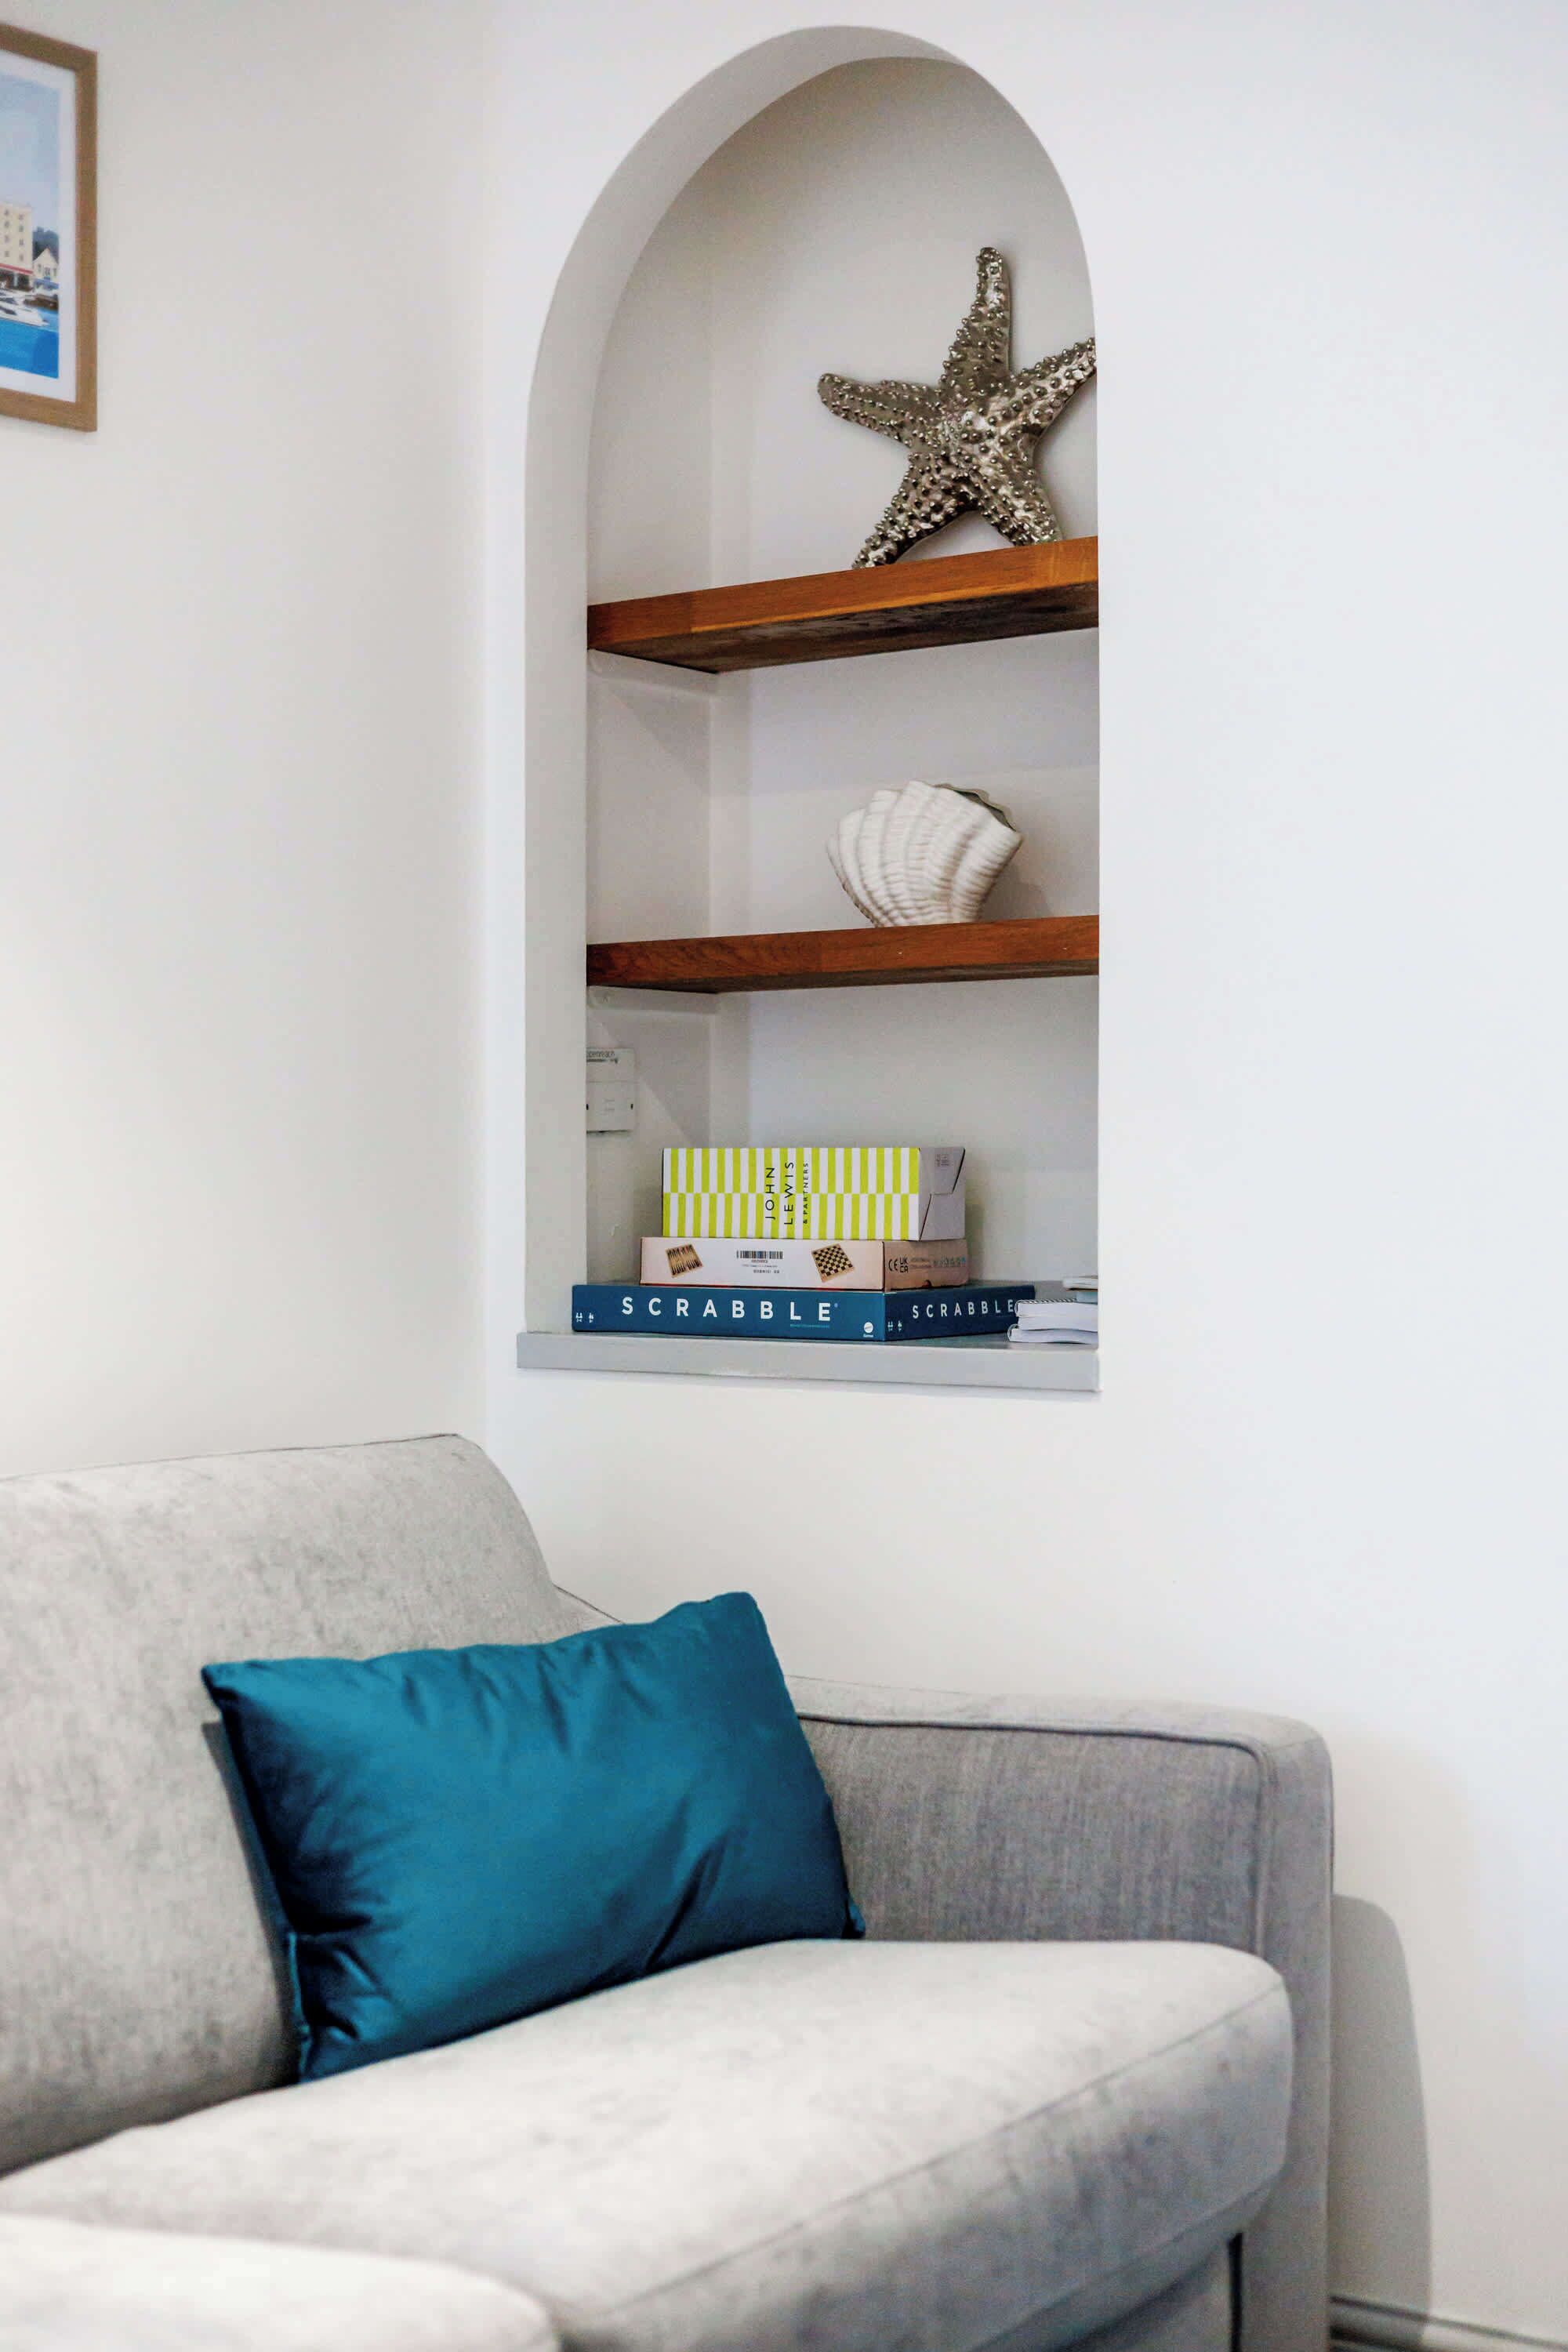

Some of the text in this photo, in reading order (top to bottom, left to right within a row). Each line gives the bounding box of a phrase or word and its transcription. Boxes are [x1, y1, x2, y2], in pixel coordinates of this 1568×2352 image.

[765, 1167, 775, 1221] JOHN
[784, 1162, 794, 1225] LEWIS
[621, 1297, 831, 1321] SCRABBLE
[912, 1299, 1014, 1319] SCRABBLE
